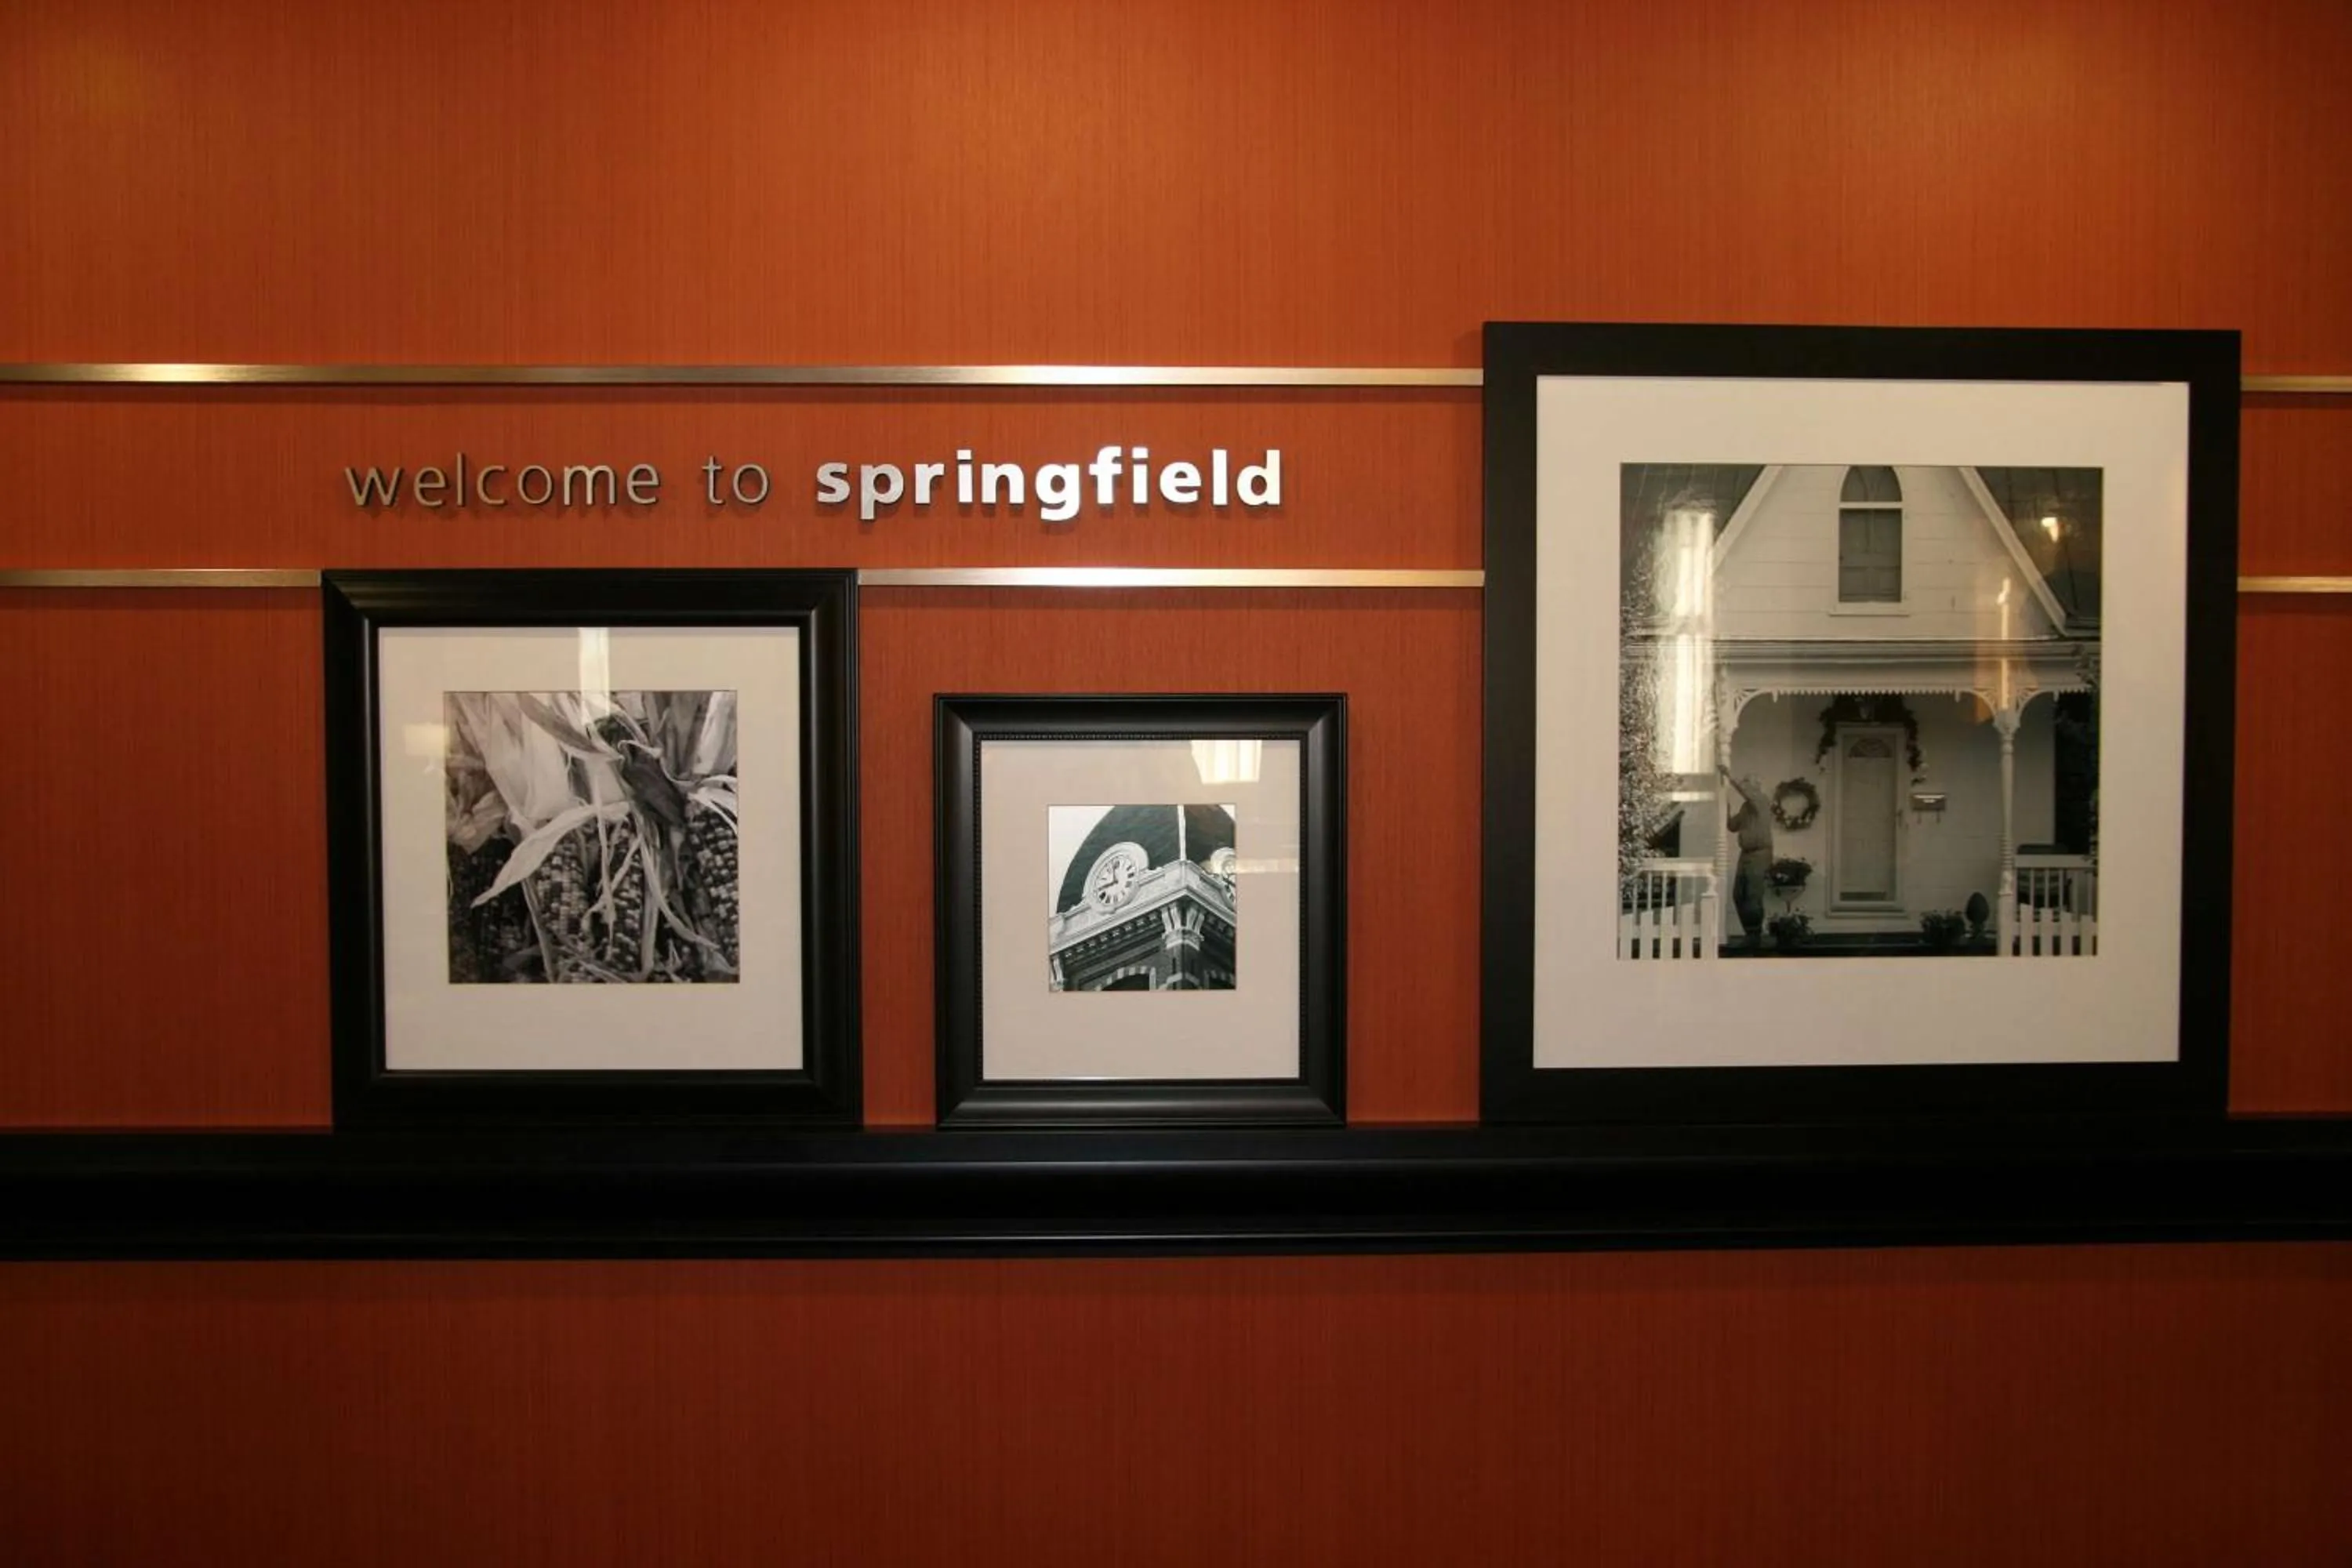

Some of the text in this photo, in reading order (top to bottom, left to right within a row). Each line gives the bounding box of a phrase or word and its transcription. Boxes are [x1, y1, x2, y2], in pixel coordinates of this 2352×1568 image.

[344, 445, 1281, 521] welcome to springfield
